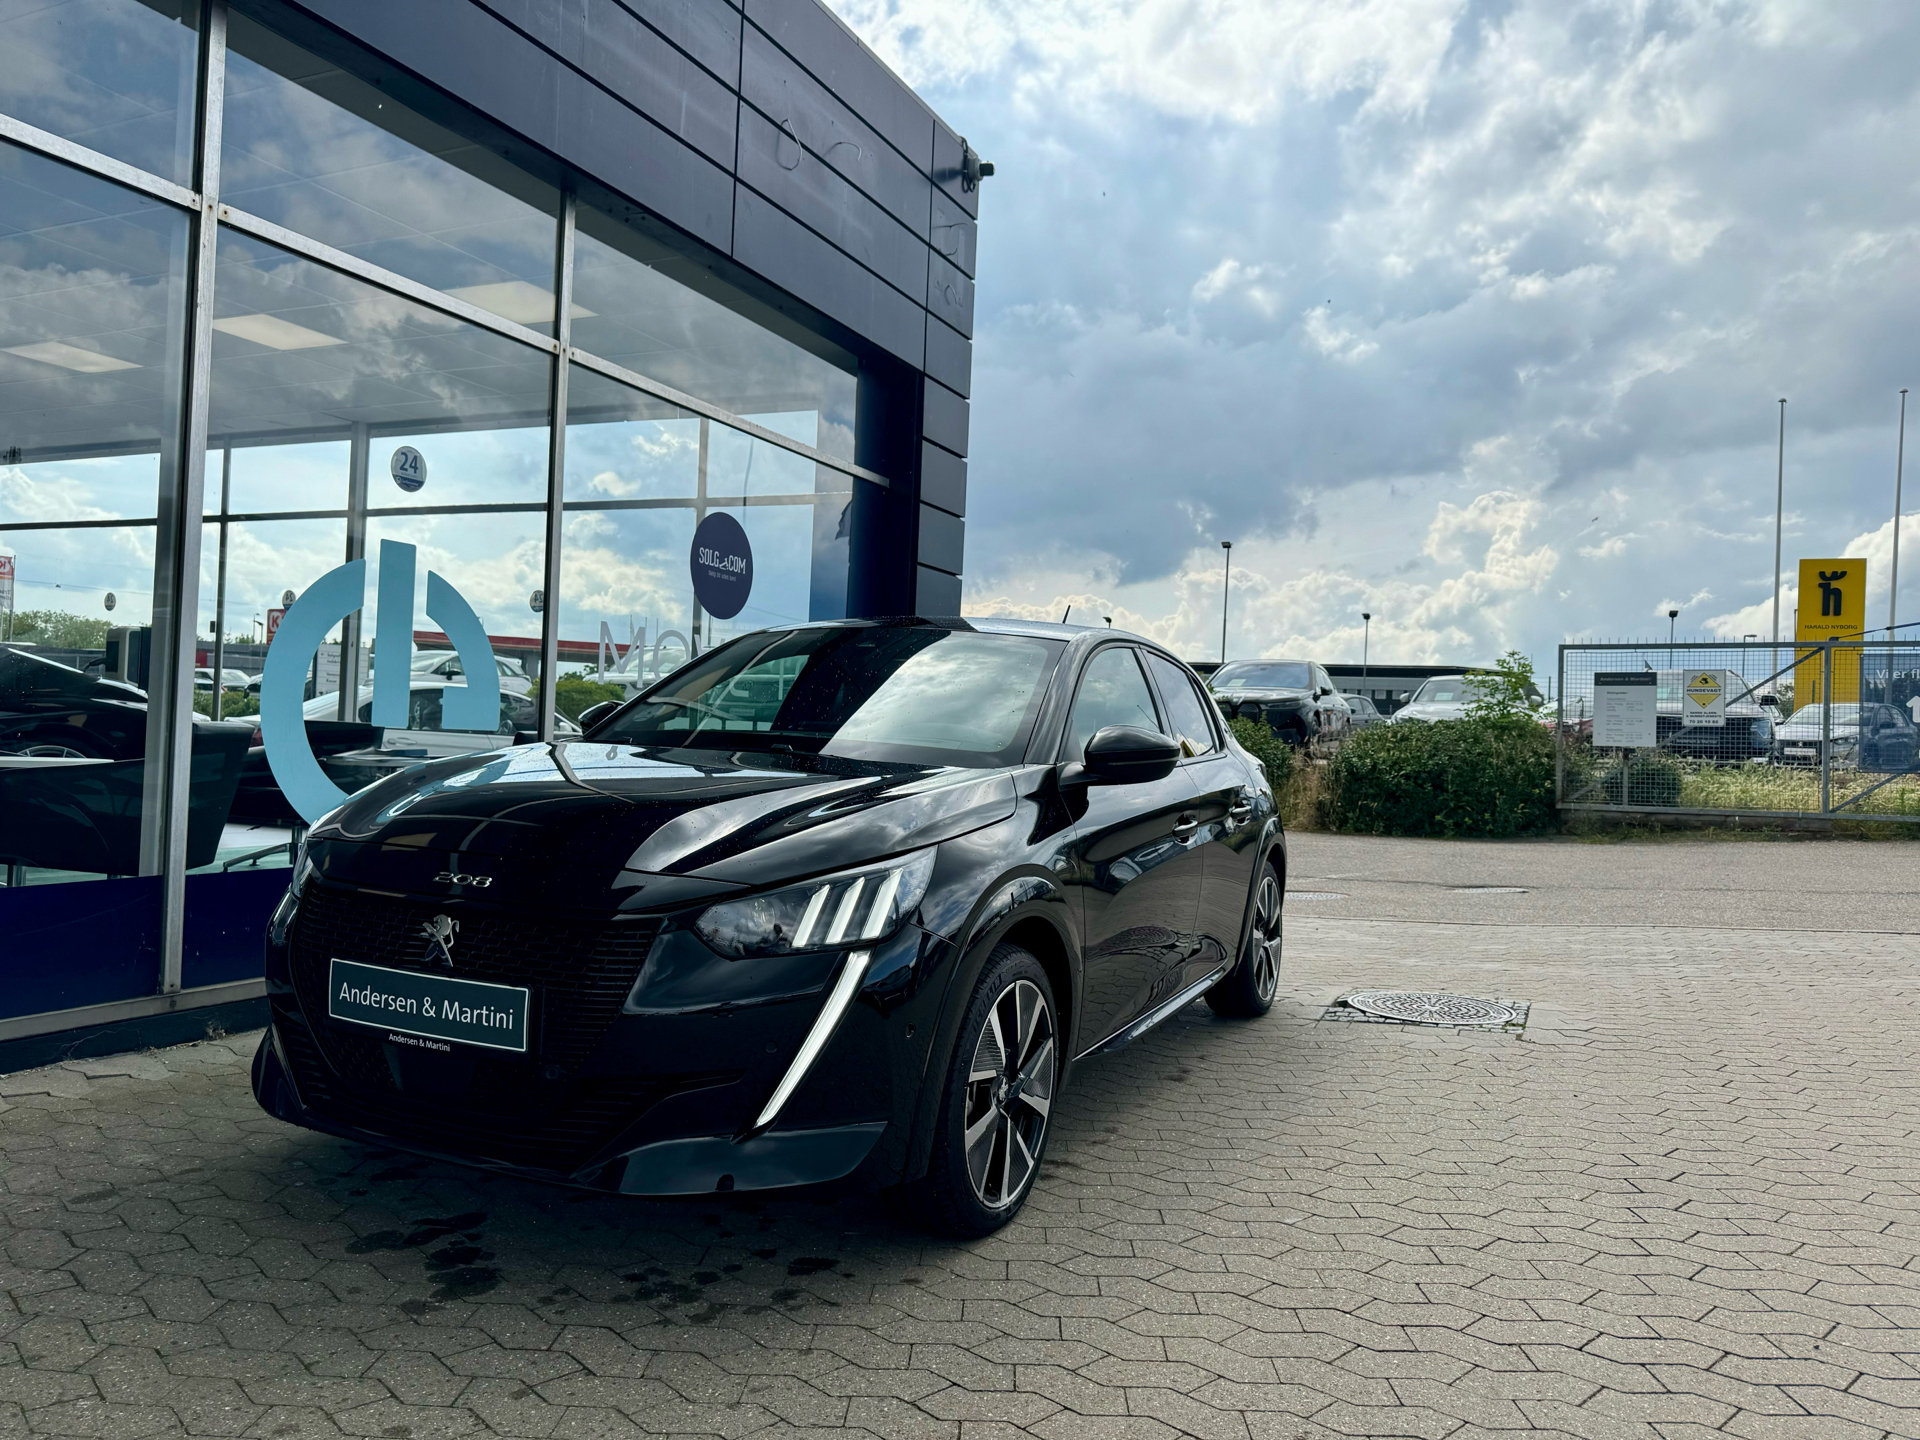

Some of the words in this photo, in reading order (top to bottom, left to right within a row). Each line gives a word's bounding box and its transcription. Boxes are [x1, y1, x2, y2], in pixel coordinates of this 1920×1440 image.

[399, 451, 419, 474] 24
[1877, 669, 1889, 679] Vi
[1893, 671, 1907, 679] er
[433, 871, 493, 887] 208
[339, 982, 417, 1014] Andersen
[422, 997, 436, 1018] &
[442, 1000, 514, 1030] Martini
[388, 1033, 418, 1046] Andersen
[426, 1041, 450, 1052] Martini
